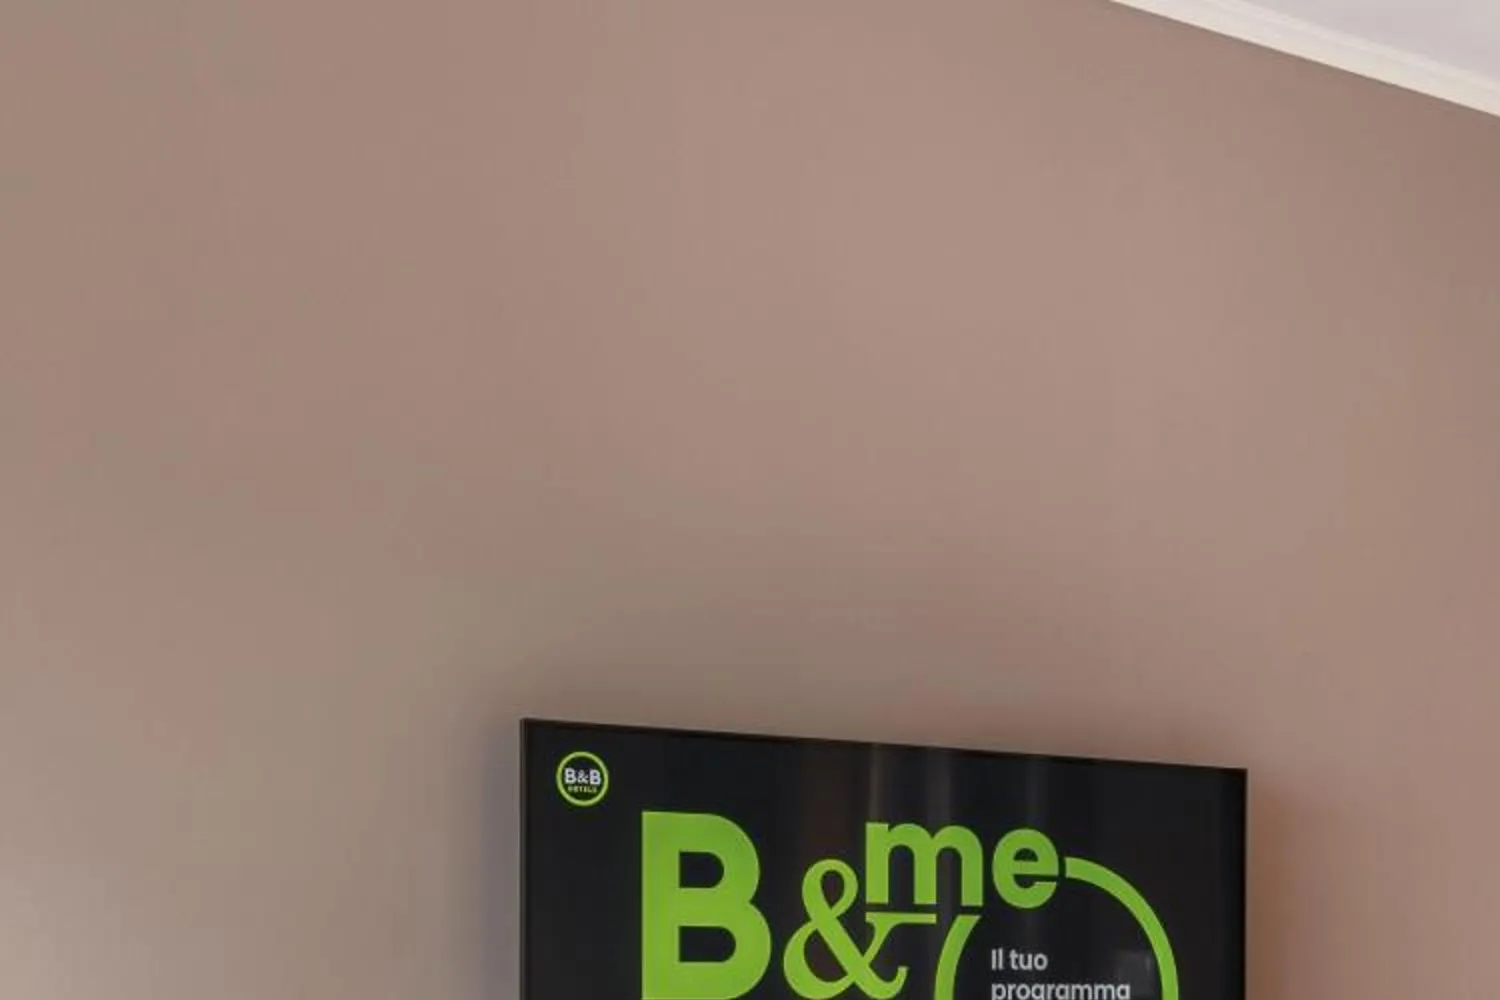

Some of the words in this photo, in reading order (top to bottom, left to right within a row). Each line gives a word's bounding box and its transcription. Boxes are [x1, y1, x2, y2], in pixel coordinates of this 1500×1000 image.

[564, 767, 602, 785] B&B
[642, 811, 1059, 1000] B&me
[991, 949, 1003, 970] Il
[1009, 949, 1048, 971] tuo
